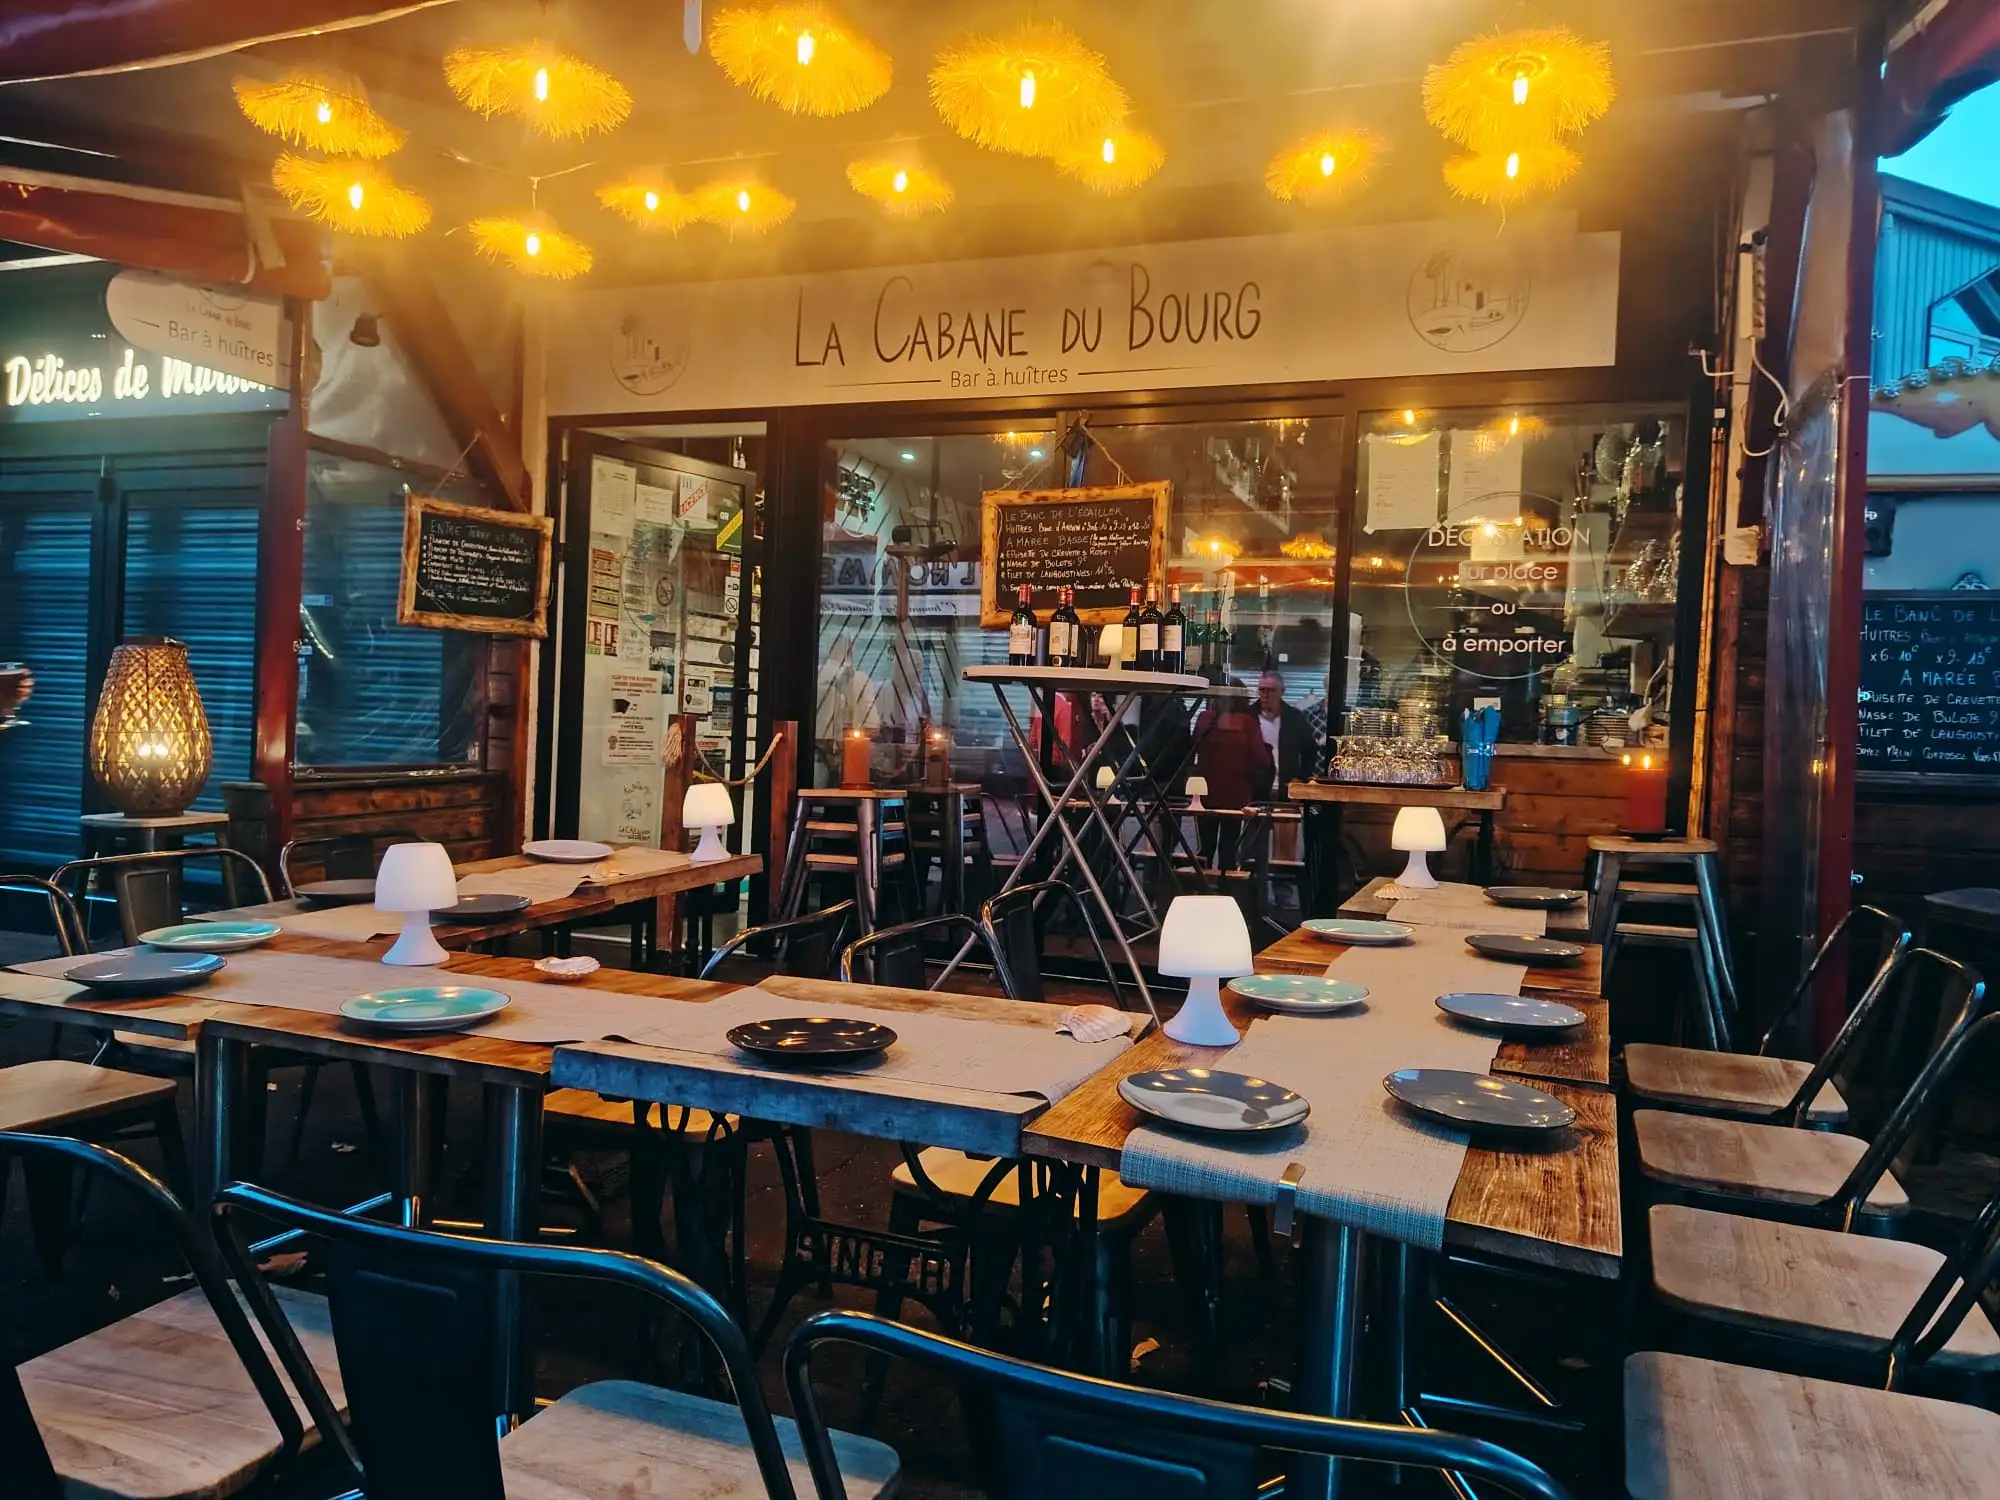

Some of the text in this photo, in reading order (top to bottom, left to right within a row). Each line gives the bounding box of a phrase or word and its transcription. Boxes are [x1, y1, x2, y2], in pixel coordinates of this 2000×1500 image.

[796, 262, 1261, 366] LA CABANE DU BOURG
[168, 320, 274, 368] Bar à huîtres
[4, 353, 104, 406] Délices
[113, 348, 150, 400] de
[950, 363, 1068, 389] Bar à huîtres
[1459, 562, 1559, 584] sur place
[1491, 602, 1517, 616] ou
[1865, 605, 1882, 622] LE
[1894, 603, 1942, 623] BANC
[1953, 609, 1976, 622] DE
[1442, 630, 1567, 656] à emporter
